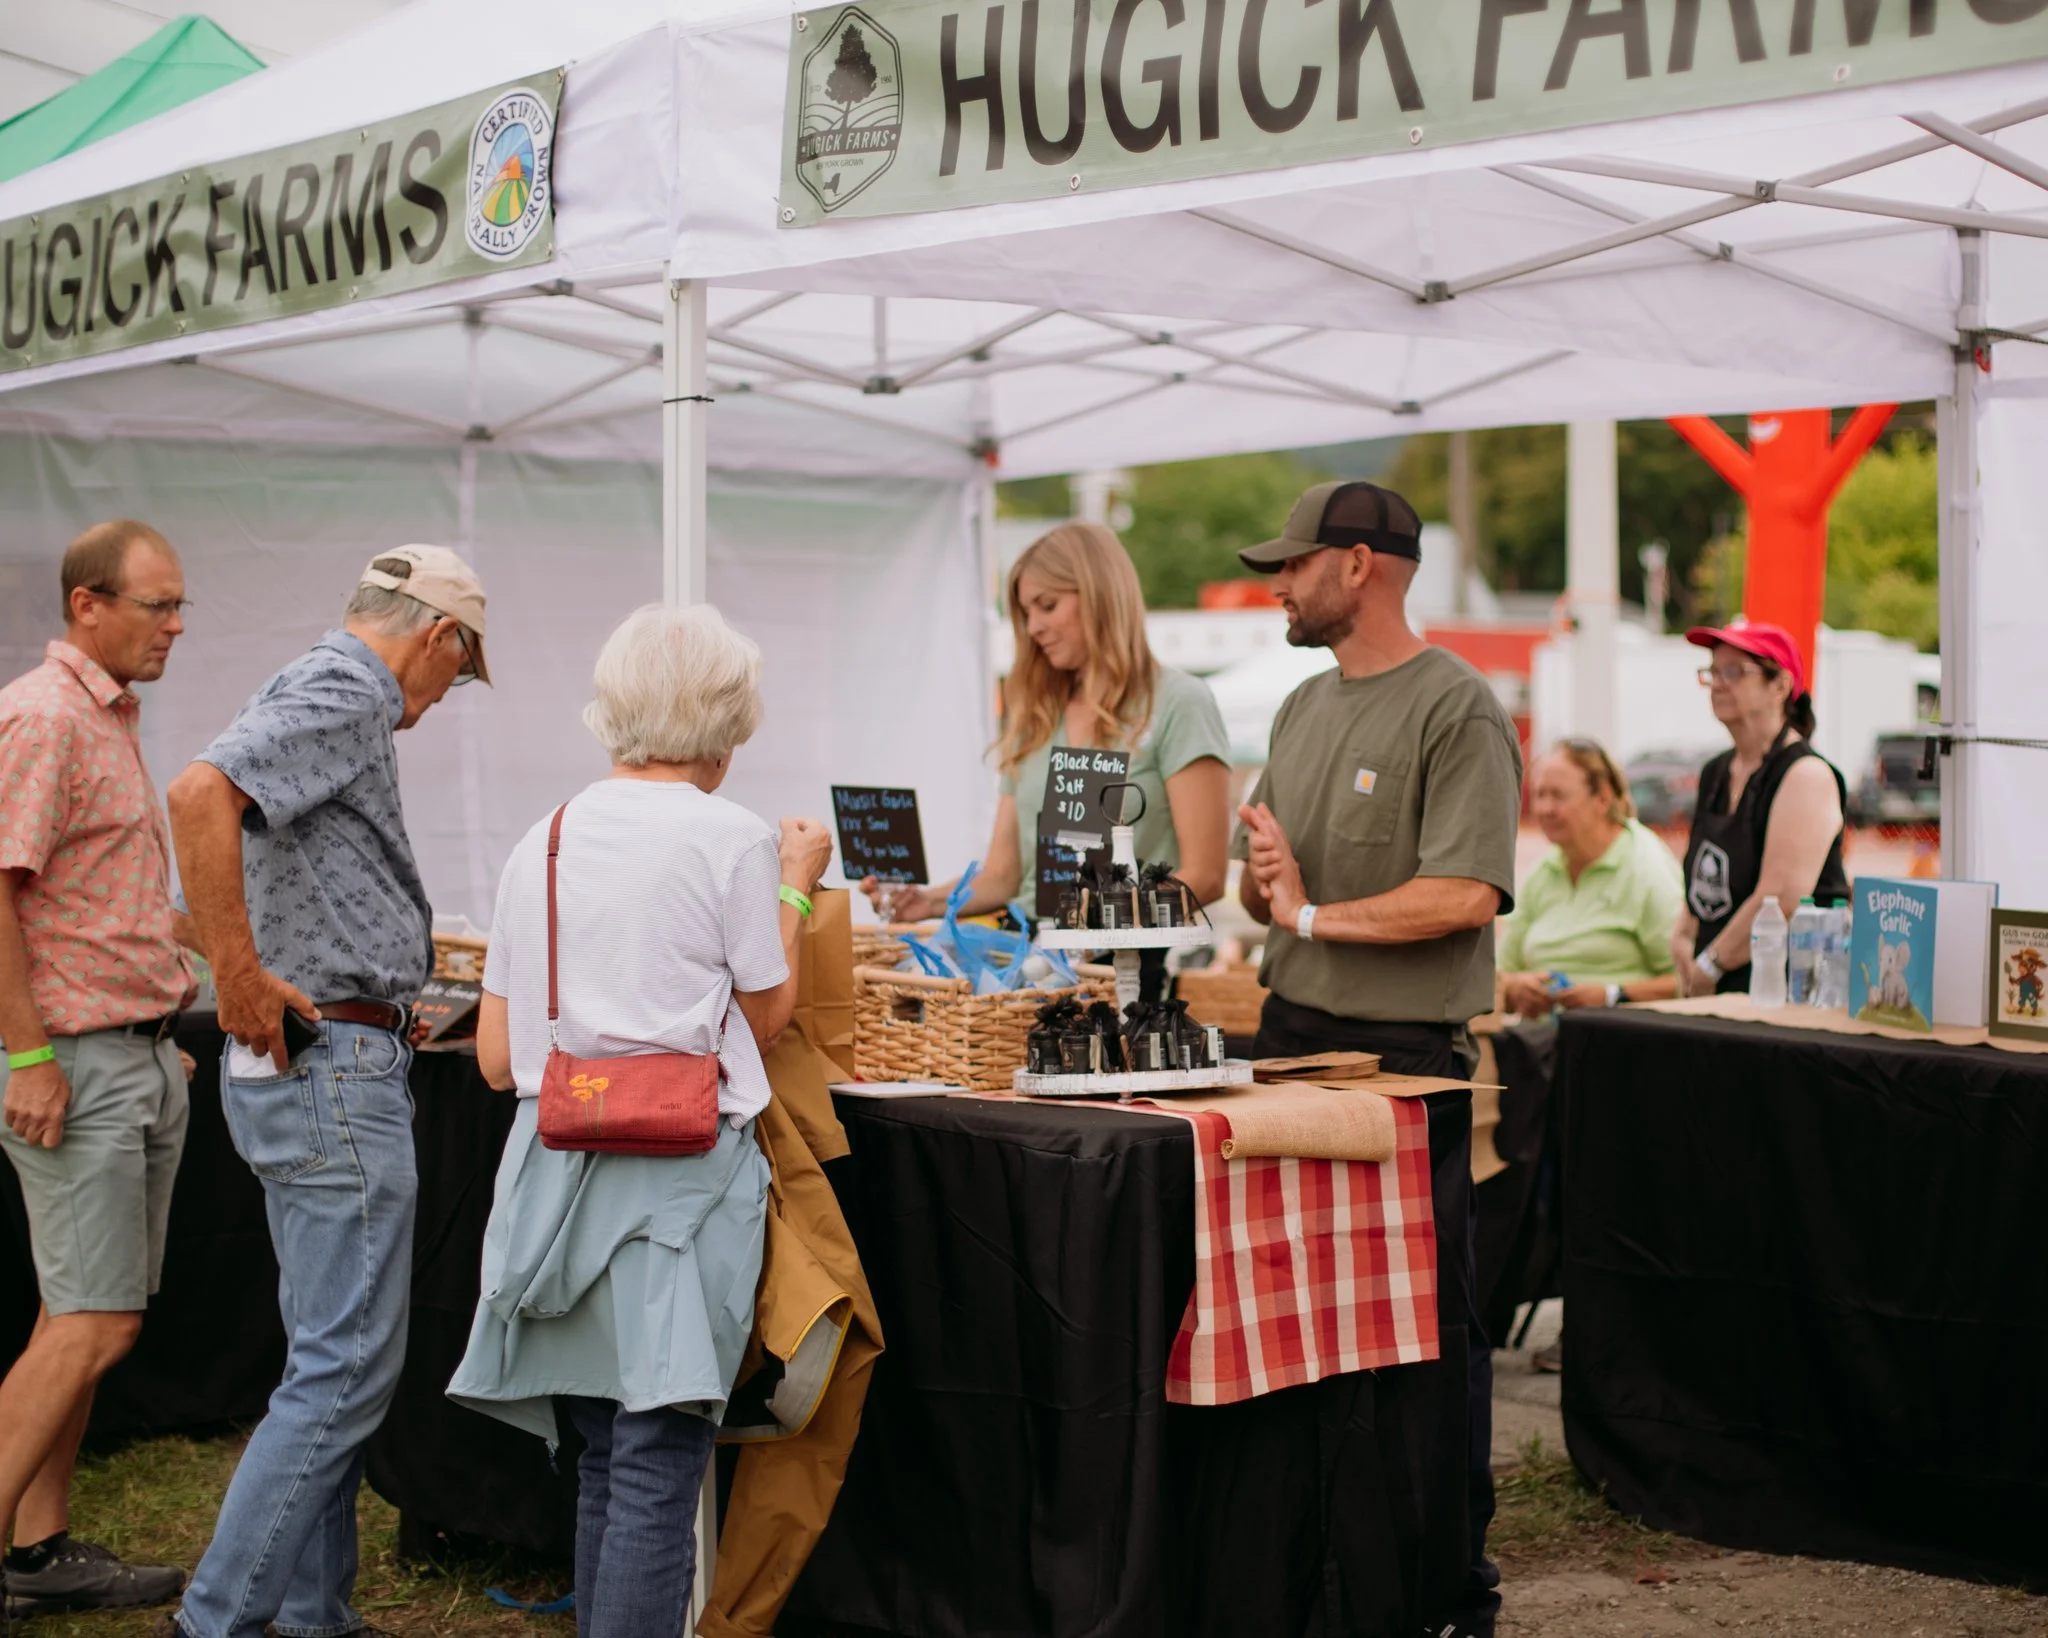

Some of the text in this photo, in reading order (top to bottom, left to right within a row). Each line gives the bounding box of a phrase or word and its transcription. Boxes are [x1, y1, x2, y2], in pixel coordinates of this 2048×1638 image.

[938, 0, 1425, 177] HUGICK
[482, 101, 543, 144] CERTIFIED
[845, 129, 889, 151] FARMS
[523, 147, 549, 229] GROWN
[2, 129, 449, 349] UGICK FARMS
[1051, 752, 1126, 775] Black Garlic
[1055, 775, 1084, 796] Salt
[1057, 801, 1086, 822] $10
[1868, 889, 1926, 922] Elephant
[1879, 911, 1912, 937] Garlic
